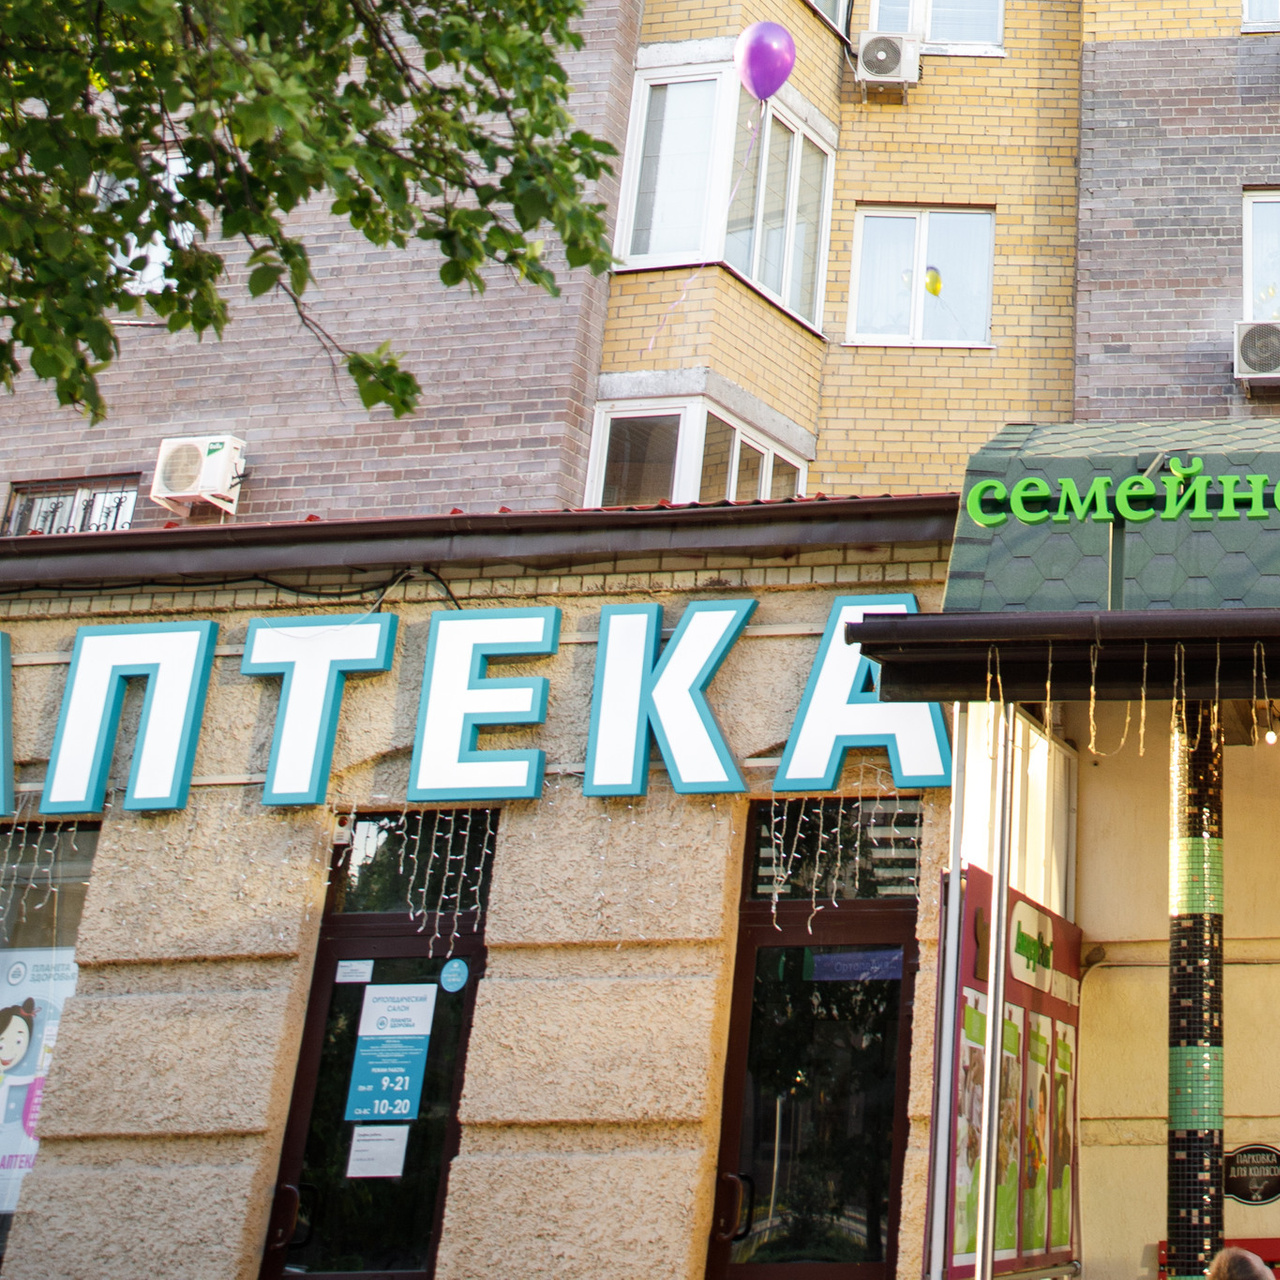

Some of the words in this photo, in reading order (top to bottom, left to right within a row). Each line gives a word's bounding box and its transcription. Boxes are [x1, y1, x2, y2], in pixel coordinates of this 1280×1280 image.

[0, 594, 952, 816] ПТЕКА
[381, 1076, 410, 1091] 9-21
[374, 1099, 411, 1114] 10-20
[1236, 1153, 1278, 1164] ПАРКОВКА
[1229, 1166, 1247, 1178] ДЛЯ
